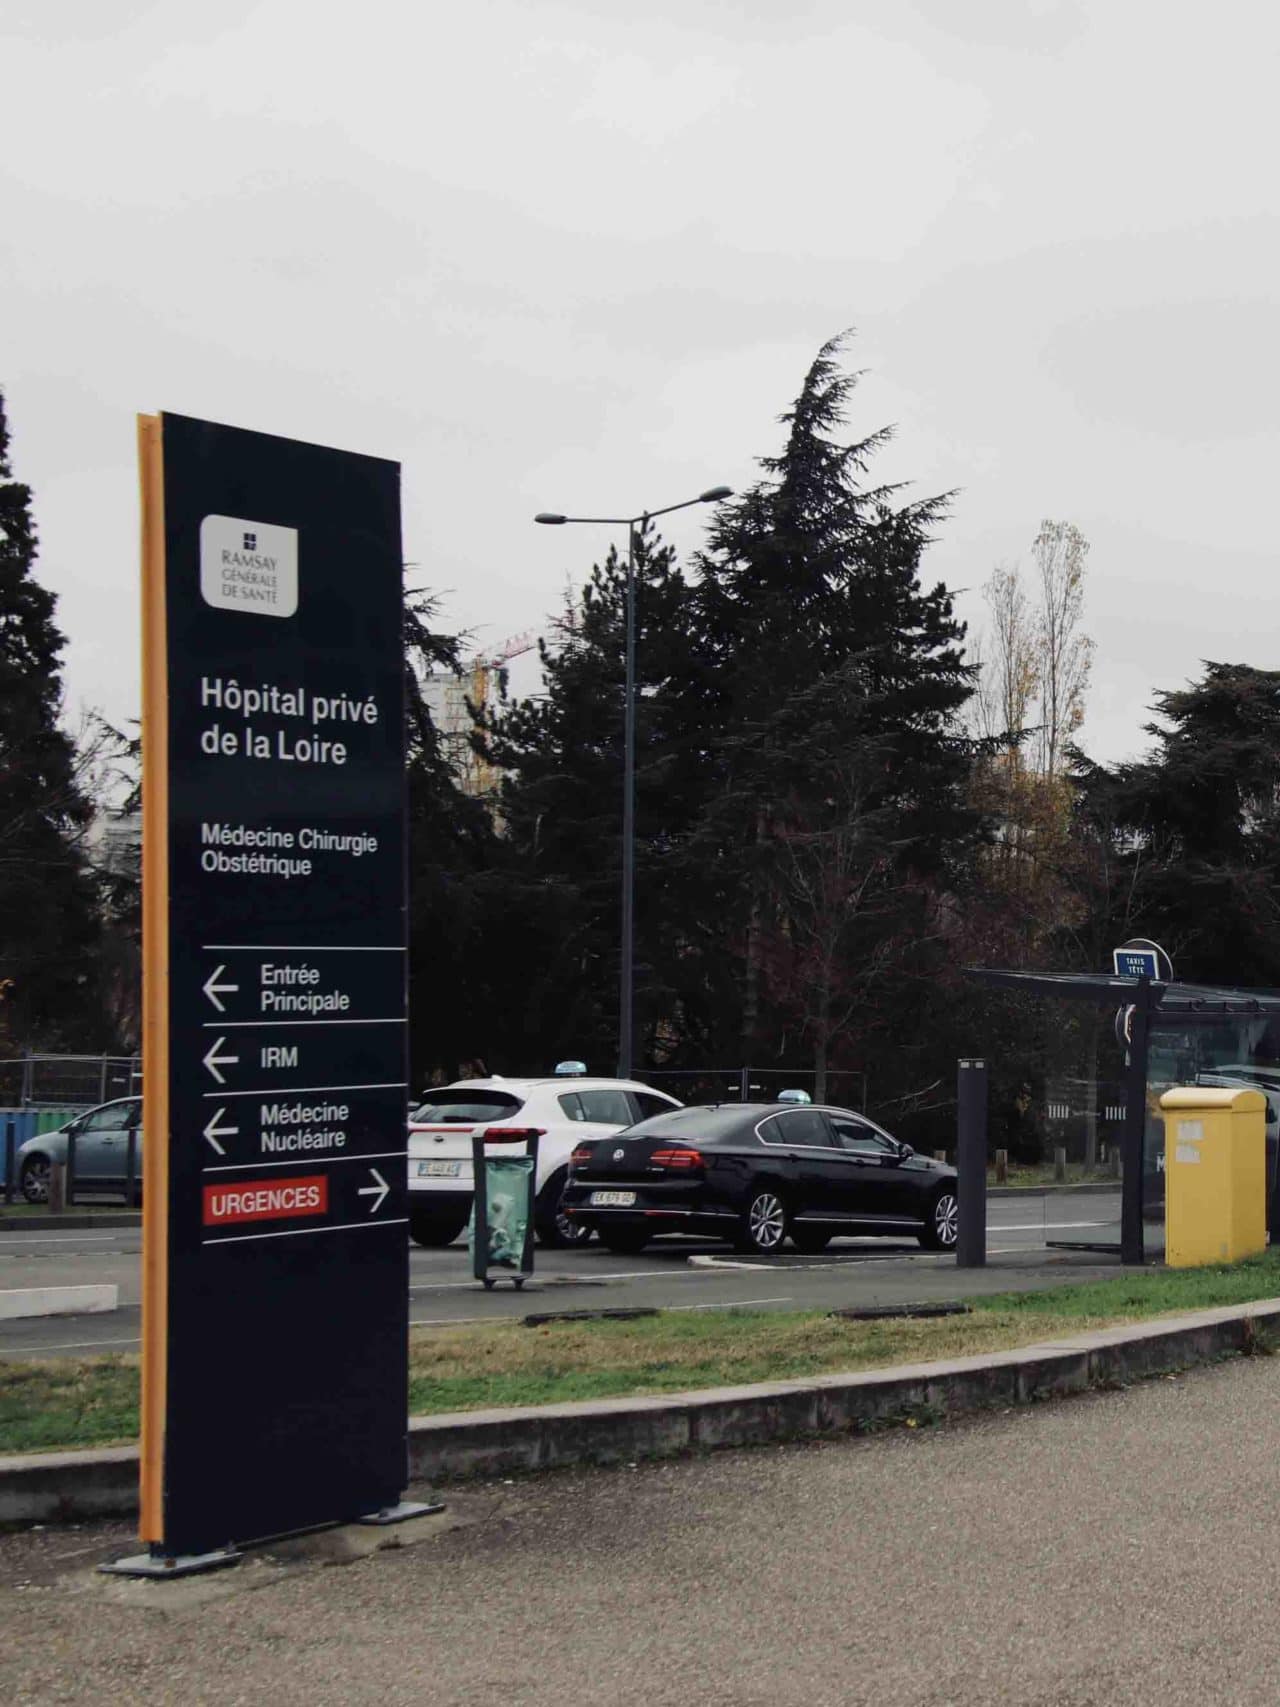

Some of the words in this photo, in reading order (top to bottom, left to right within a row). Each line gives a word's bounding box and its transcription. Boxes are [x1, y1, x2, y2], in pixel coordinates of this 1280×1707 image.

[222, 549, 277, 571] RAMSAY
[222, 584, 238, 599] DE
[201, 676, 305, 719] Hôpital
[312, 693, 379, 725] privé
[201, 724, 239, 756] de
[245, 727, 271, 759] la
[278, 730, 347, 766] Loire
[201, 823, 294, 849] Médecine
[298, 828, 378, 857] Chirurgie
[201, 850, 312, 879] Obstétrique
[261, 964, 320, 985] Entrée
[261, 990, 350, 1015] Principale
[261, 1047, 298, 1069] IRM
[261, 1102, 349, 1125] Médecine
[261, 1128, 346, 1152] Nucléaire
[211, 1186, 320, 1216] URGENCES
